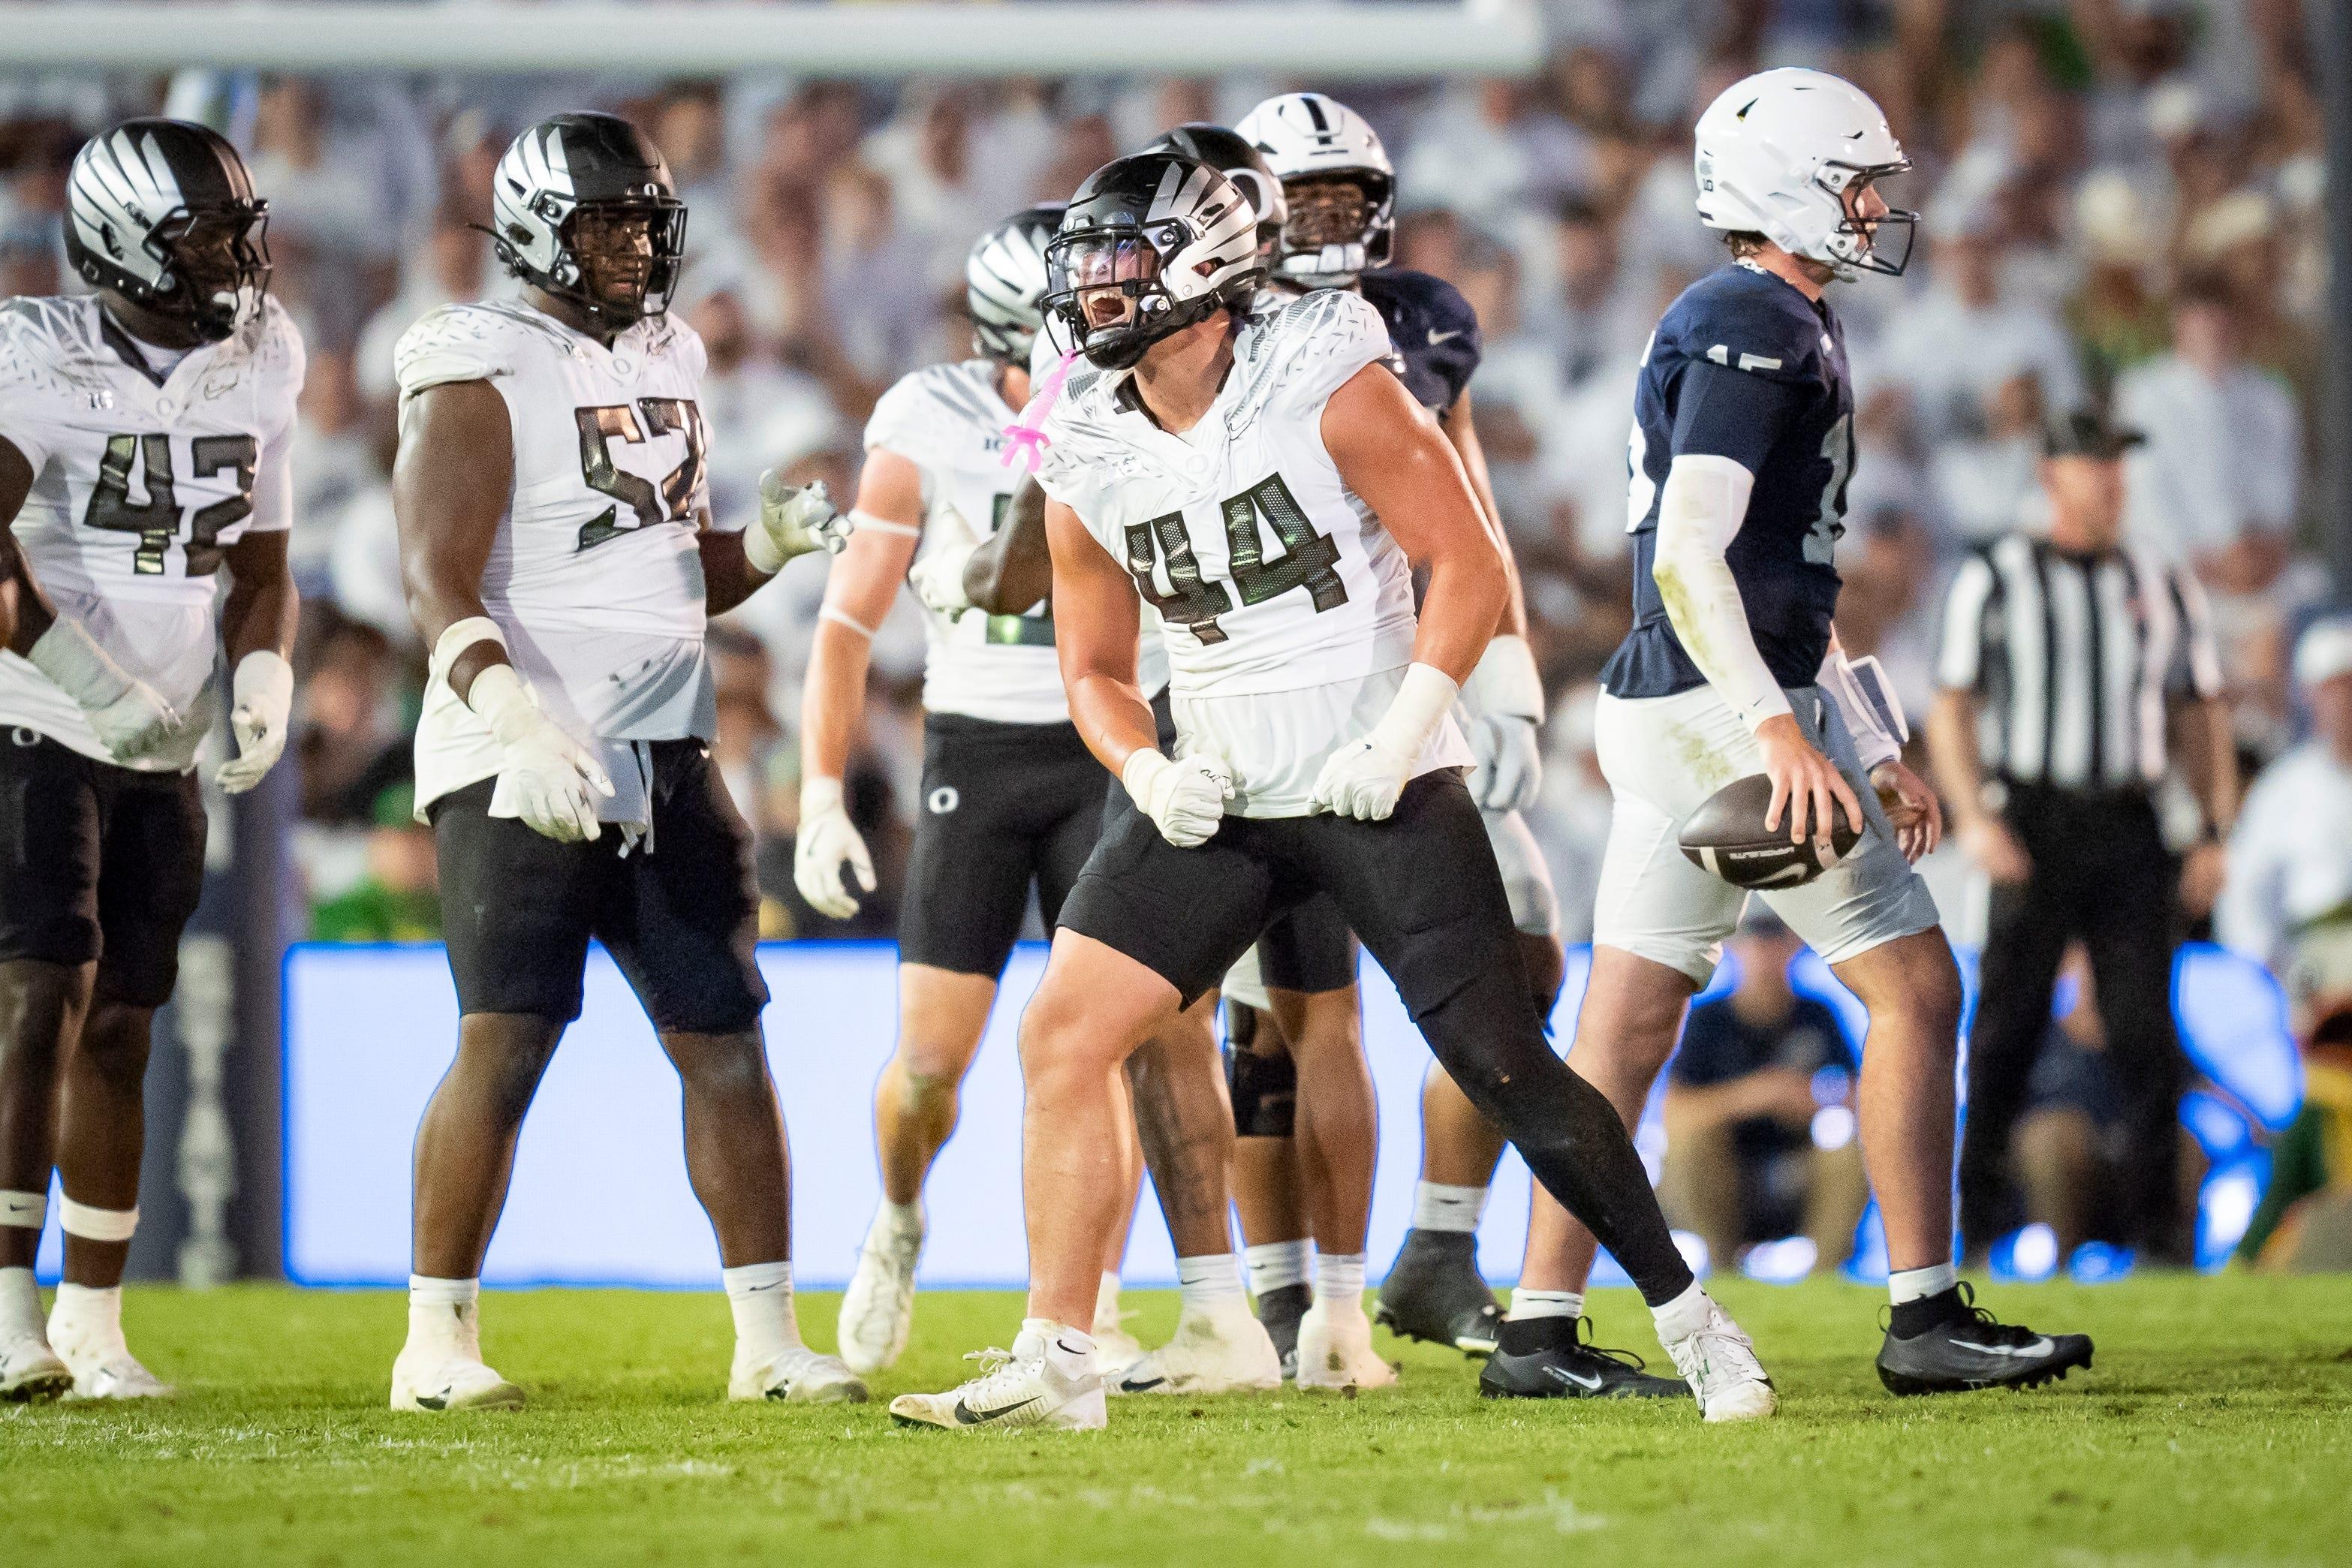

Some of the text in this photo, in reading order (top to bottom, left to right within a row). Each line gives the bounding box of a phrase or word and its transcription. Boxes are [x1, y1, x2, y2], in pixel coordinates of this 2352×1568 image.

[84, 433, 257, 577] 42
[574, 396, 706, 552] 57
[1125, 471, 1350, 647] 44
[929, 787, 959, 814] O
